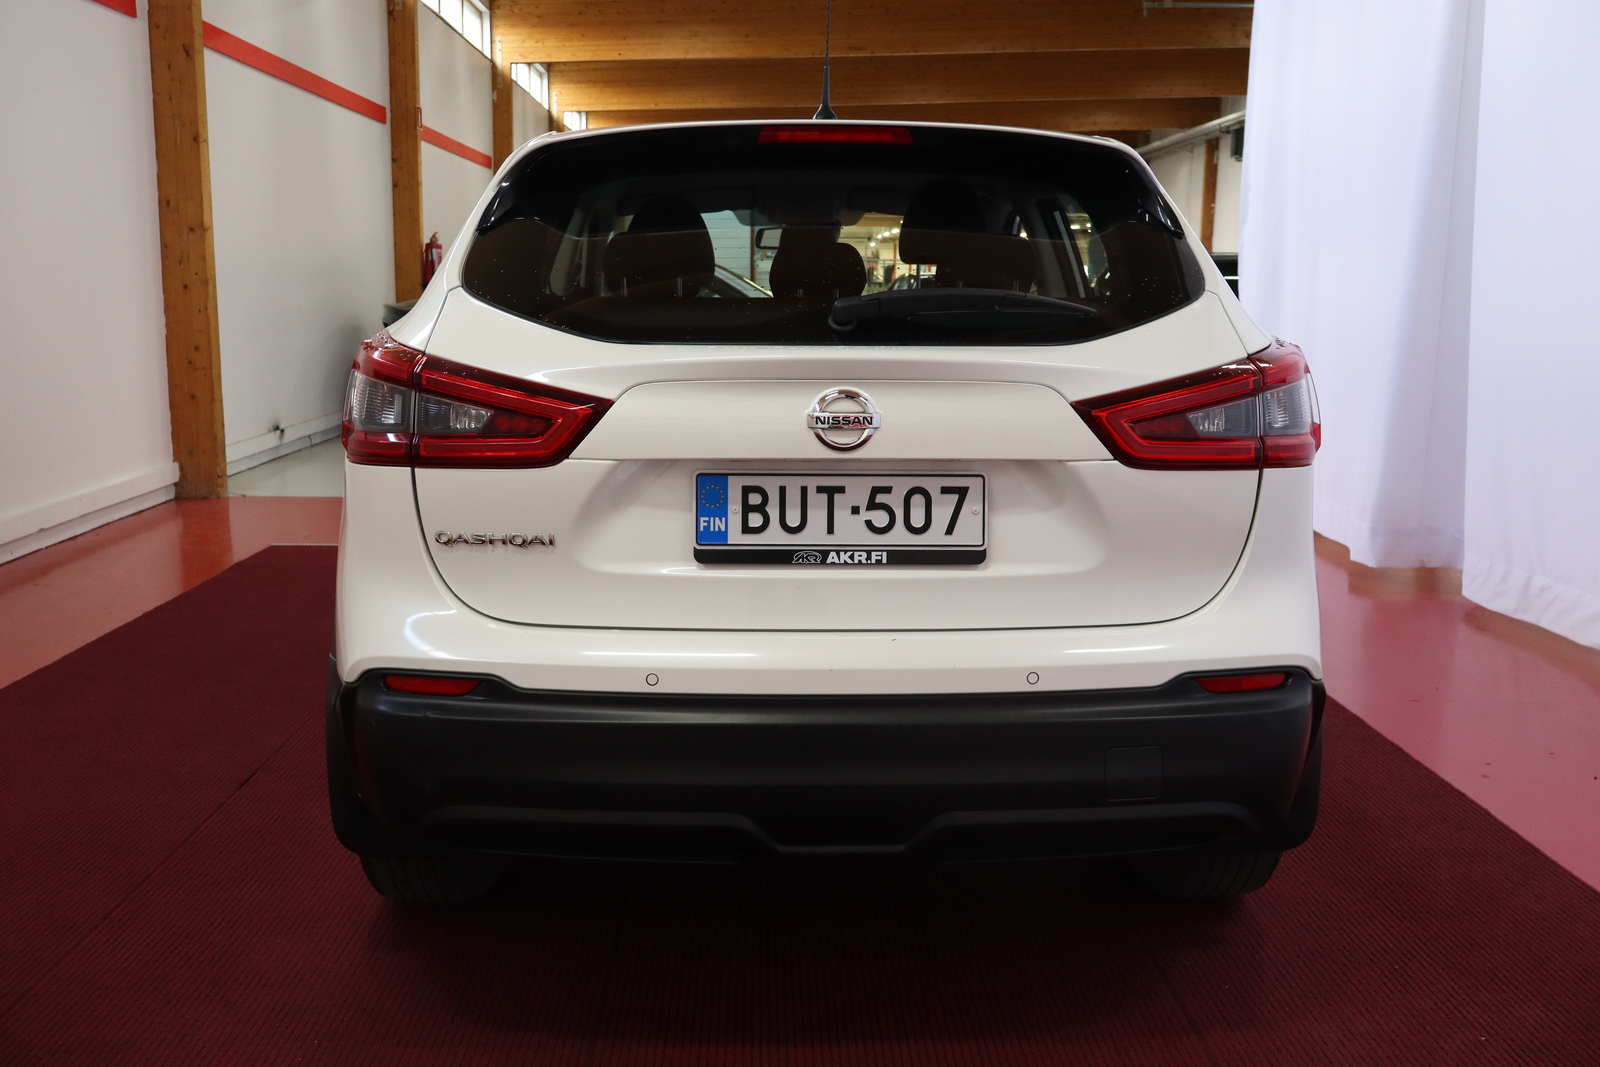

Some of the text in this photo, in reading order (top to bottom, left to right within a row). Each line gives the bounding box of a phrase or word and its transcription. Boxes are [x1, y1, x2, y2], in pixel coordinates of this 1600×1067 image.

[815, 416, 873, 426] NISSAN
[700, 517, 726, 532] FIN
[435, 530, 555, 548] QASHQAI
[826, 551, 888, 564] AKR.FI
